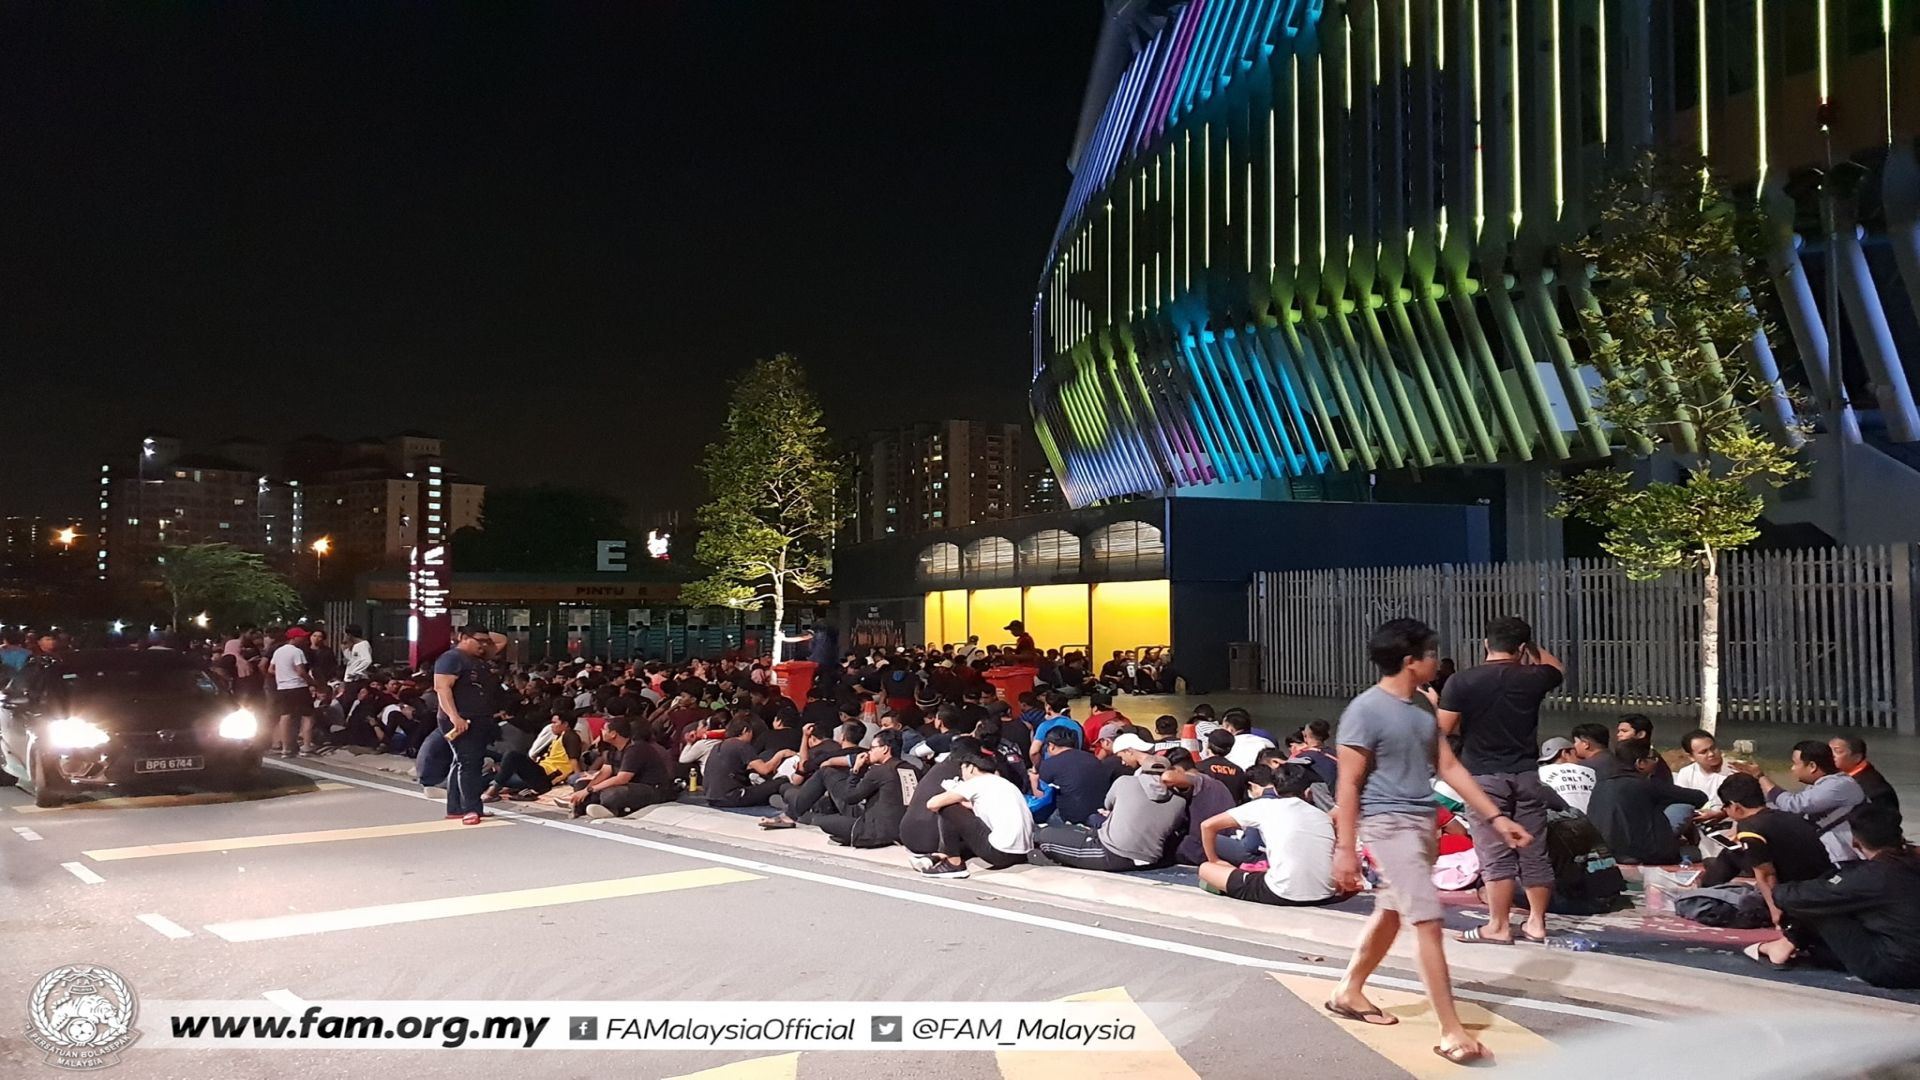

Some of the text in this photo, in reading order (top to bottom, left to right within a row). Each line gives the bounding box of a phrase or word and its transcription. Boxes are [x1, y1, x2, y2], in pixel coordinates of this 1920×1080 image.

[597, 540, 627, 571] E
[576, 587, 624, 595] PINTU
[1210, 765, 1236, 775] CREW
